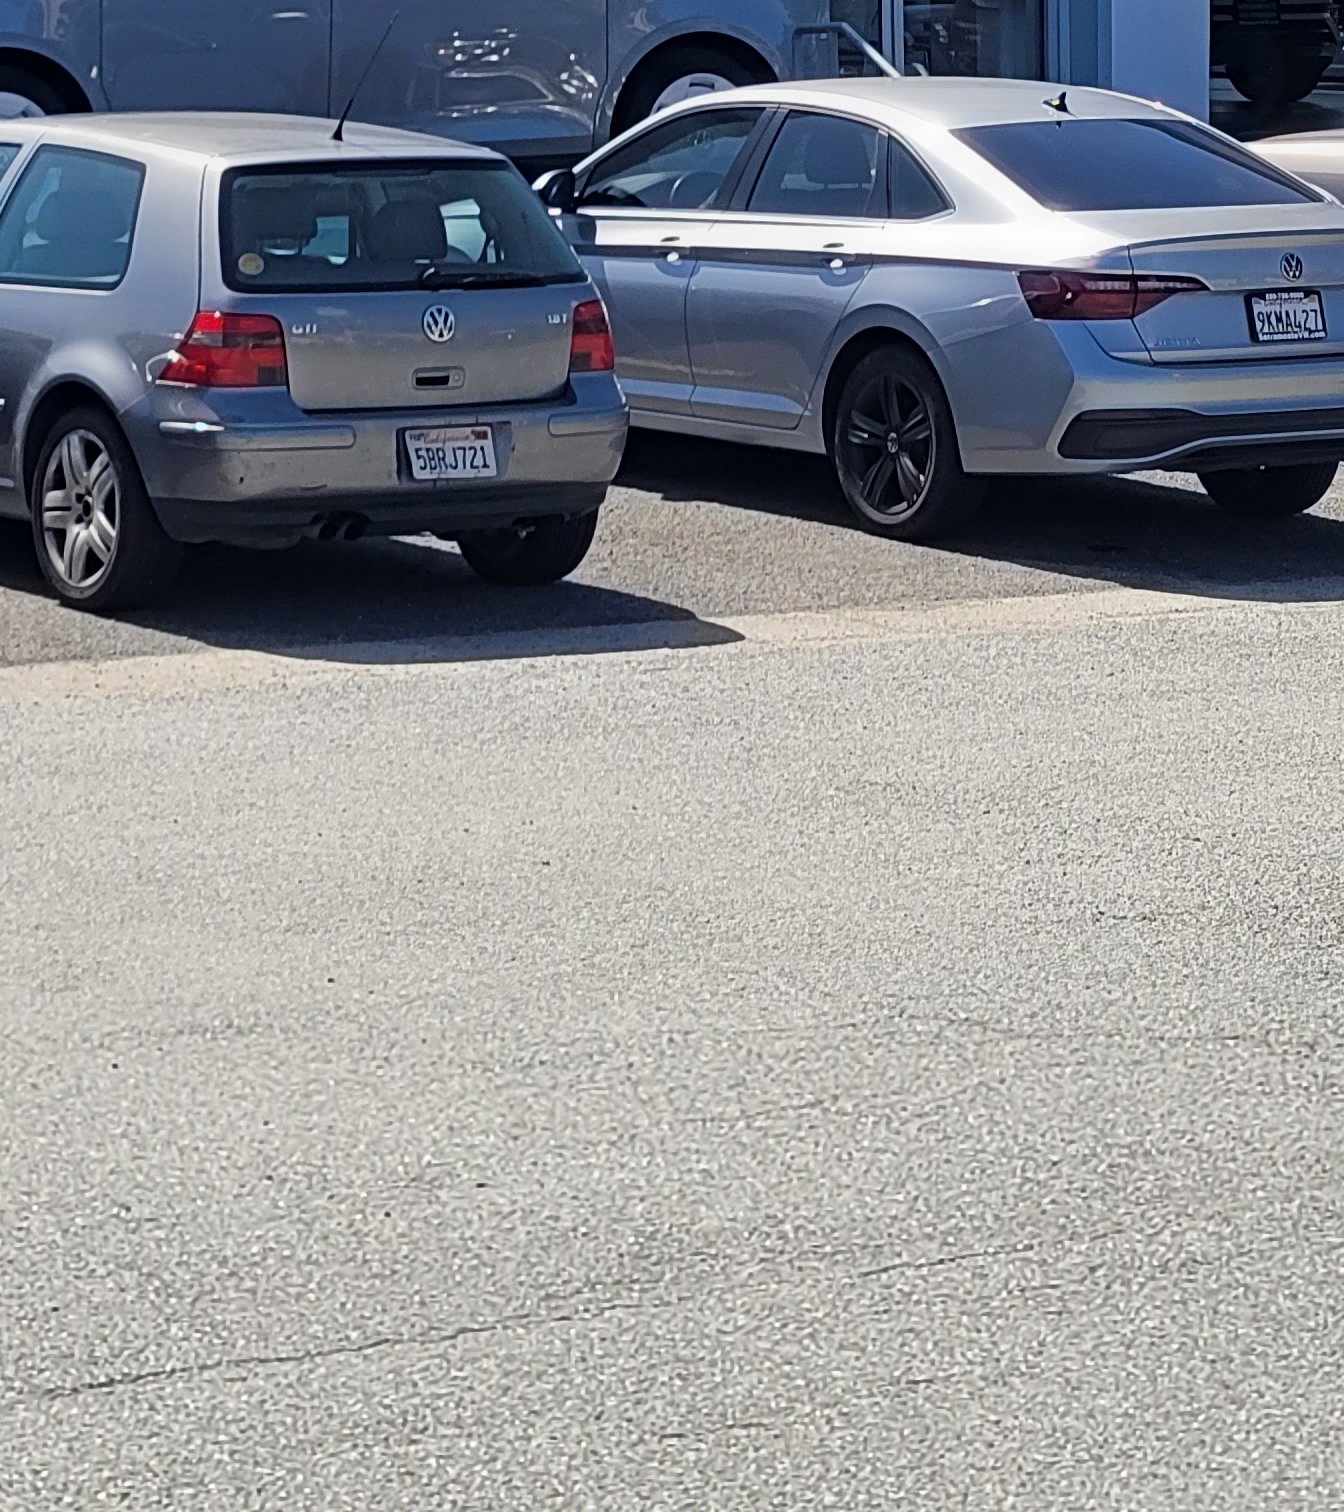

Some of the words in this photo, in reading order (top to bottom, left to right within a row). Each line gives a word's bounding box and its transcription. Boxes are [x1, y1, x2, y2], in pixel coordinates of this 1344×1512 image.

[1280, 252, 1303, 281] VW
[423, 305, 455, 341] VW
[1257, 309, 1319, 333] 9KMA427
[415, 445, 490, 470] 5BRJ721
